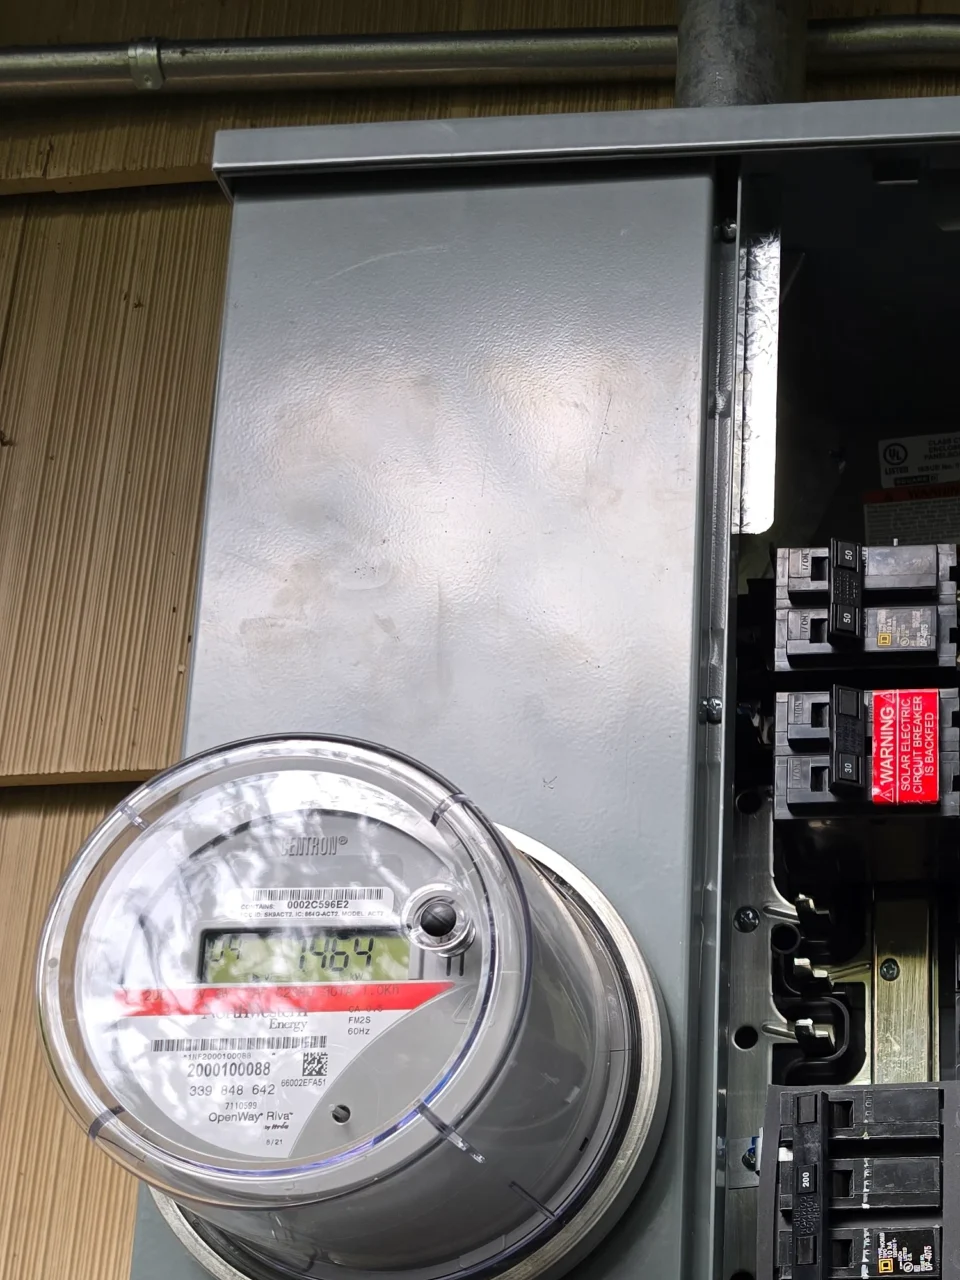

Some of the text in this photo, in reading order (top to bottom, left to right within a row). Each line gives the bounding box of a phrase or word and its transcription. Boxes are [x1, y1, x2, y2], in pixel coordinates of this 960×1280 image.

[845, 550, 852, 560] 50
[844, 613, 851, 623] 50
[880, 707, 894, 786] WARNING
[901, 699, 910, 791] SOLAR ELECTRIC
[913, 696, 922, 794] CIRCUIT BREAKER
[925, 713, 934, 776] IS BACKFED
[845, 763, 852, 773] 30
[287, 901, 349, 909] 0002C596E2
[269, 1018, 308, 1031] Energy
[188, 1062, 270, 1078] 2000100088
[281, 1079, 326, 1088] 66002EFA51
[190, 1084, 275, 1096] 339 848 642
[225, 1102, 257, 1110] 7110599
[802, 1171, 810, 1187] 200
